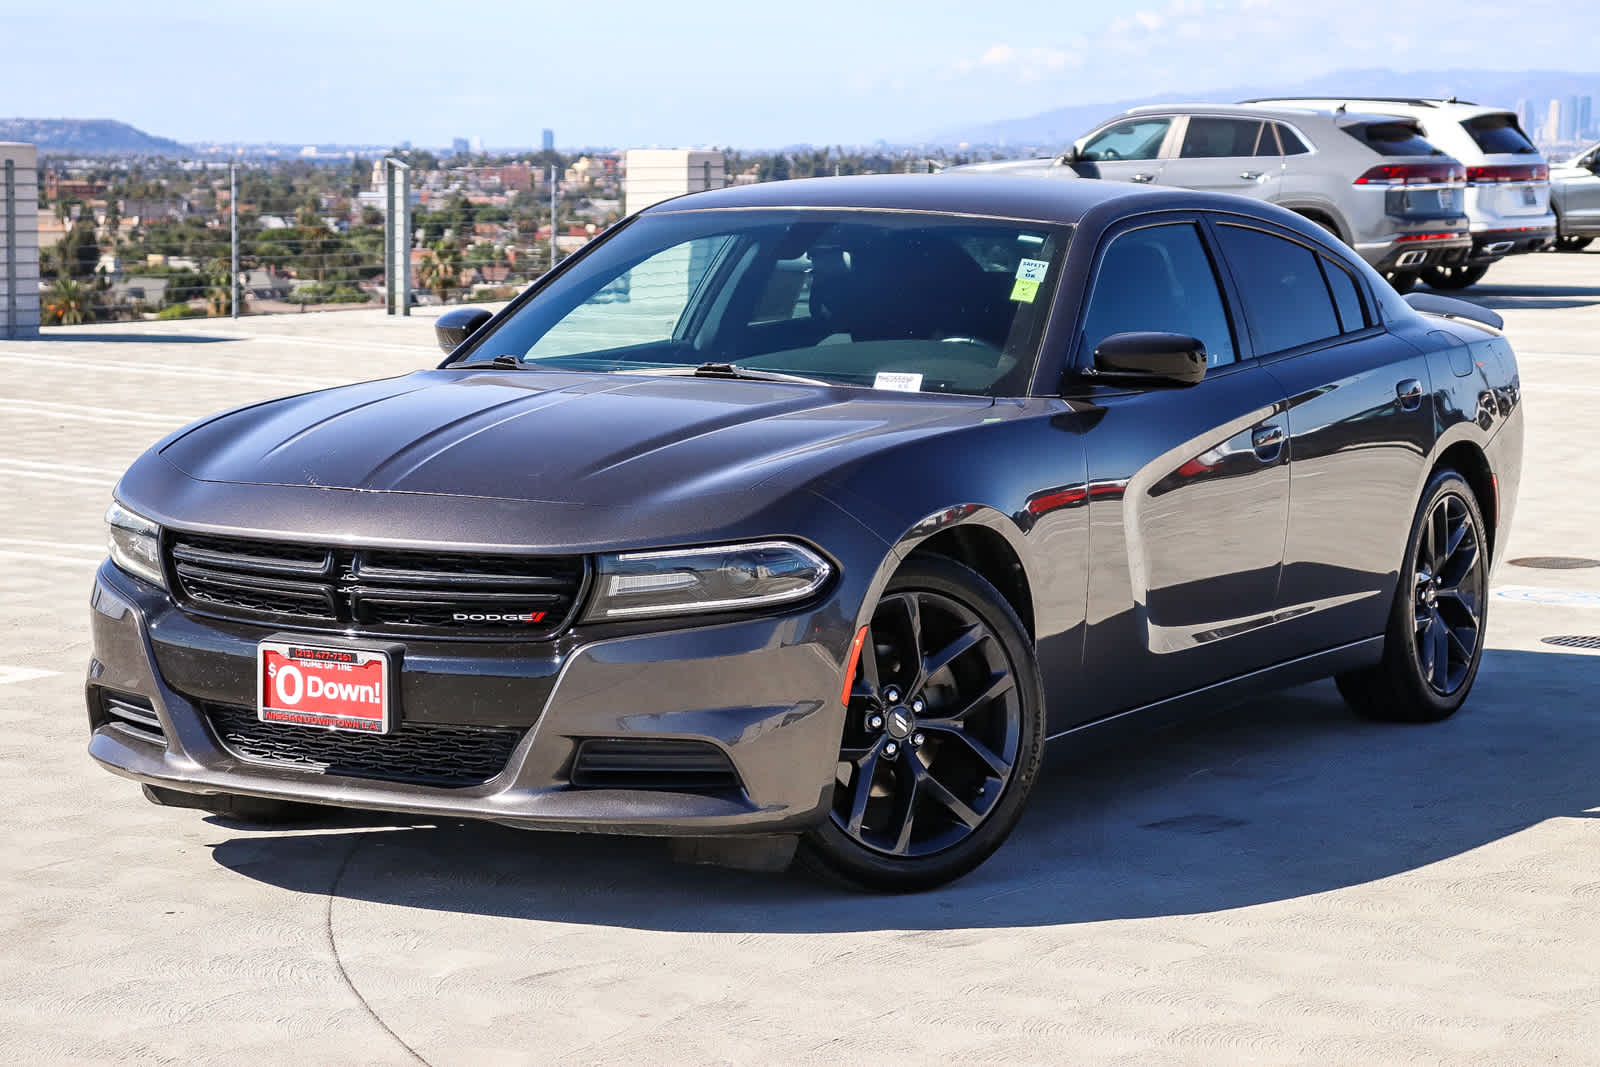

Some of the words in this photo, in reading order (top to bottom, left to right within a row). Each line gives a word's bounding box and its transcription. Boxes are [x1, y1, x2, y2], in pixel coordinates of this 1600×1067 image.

[453, 613, 534, 621] DODGE
[295, 648, 314, 659] (213)
[300, 660, 322, 669] HOME
[324, 662, 335, 670] OF
[337, 663, 353, 672] THE
[306, 675, 380, 704] Down!
[265, 711, 303, 722] NISSAN
[304, 715, 360, 728] DOWNTOWN
